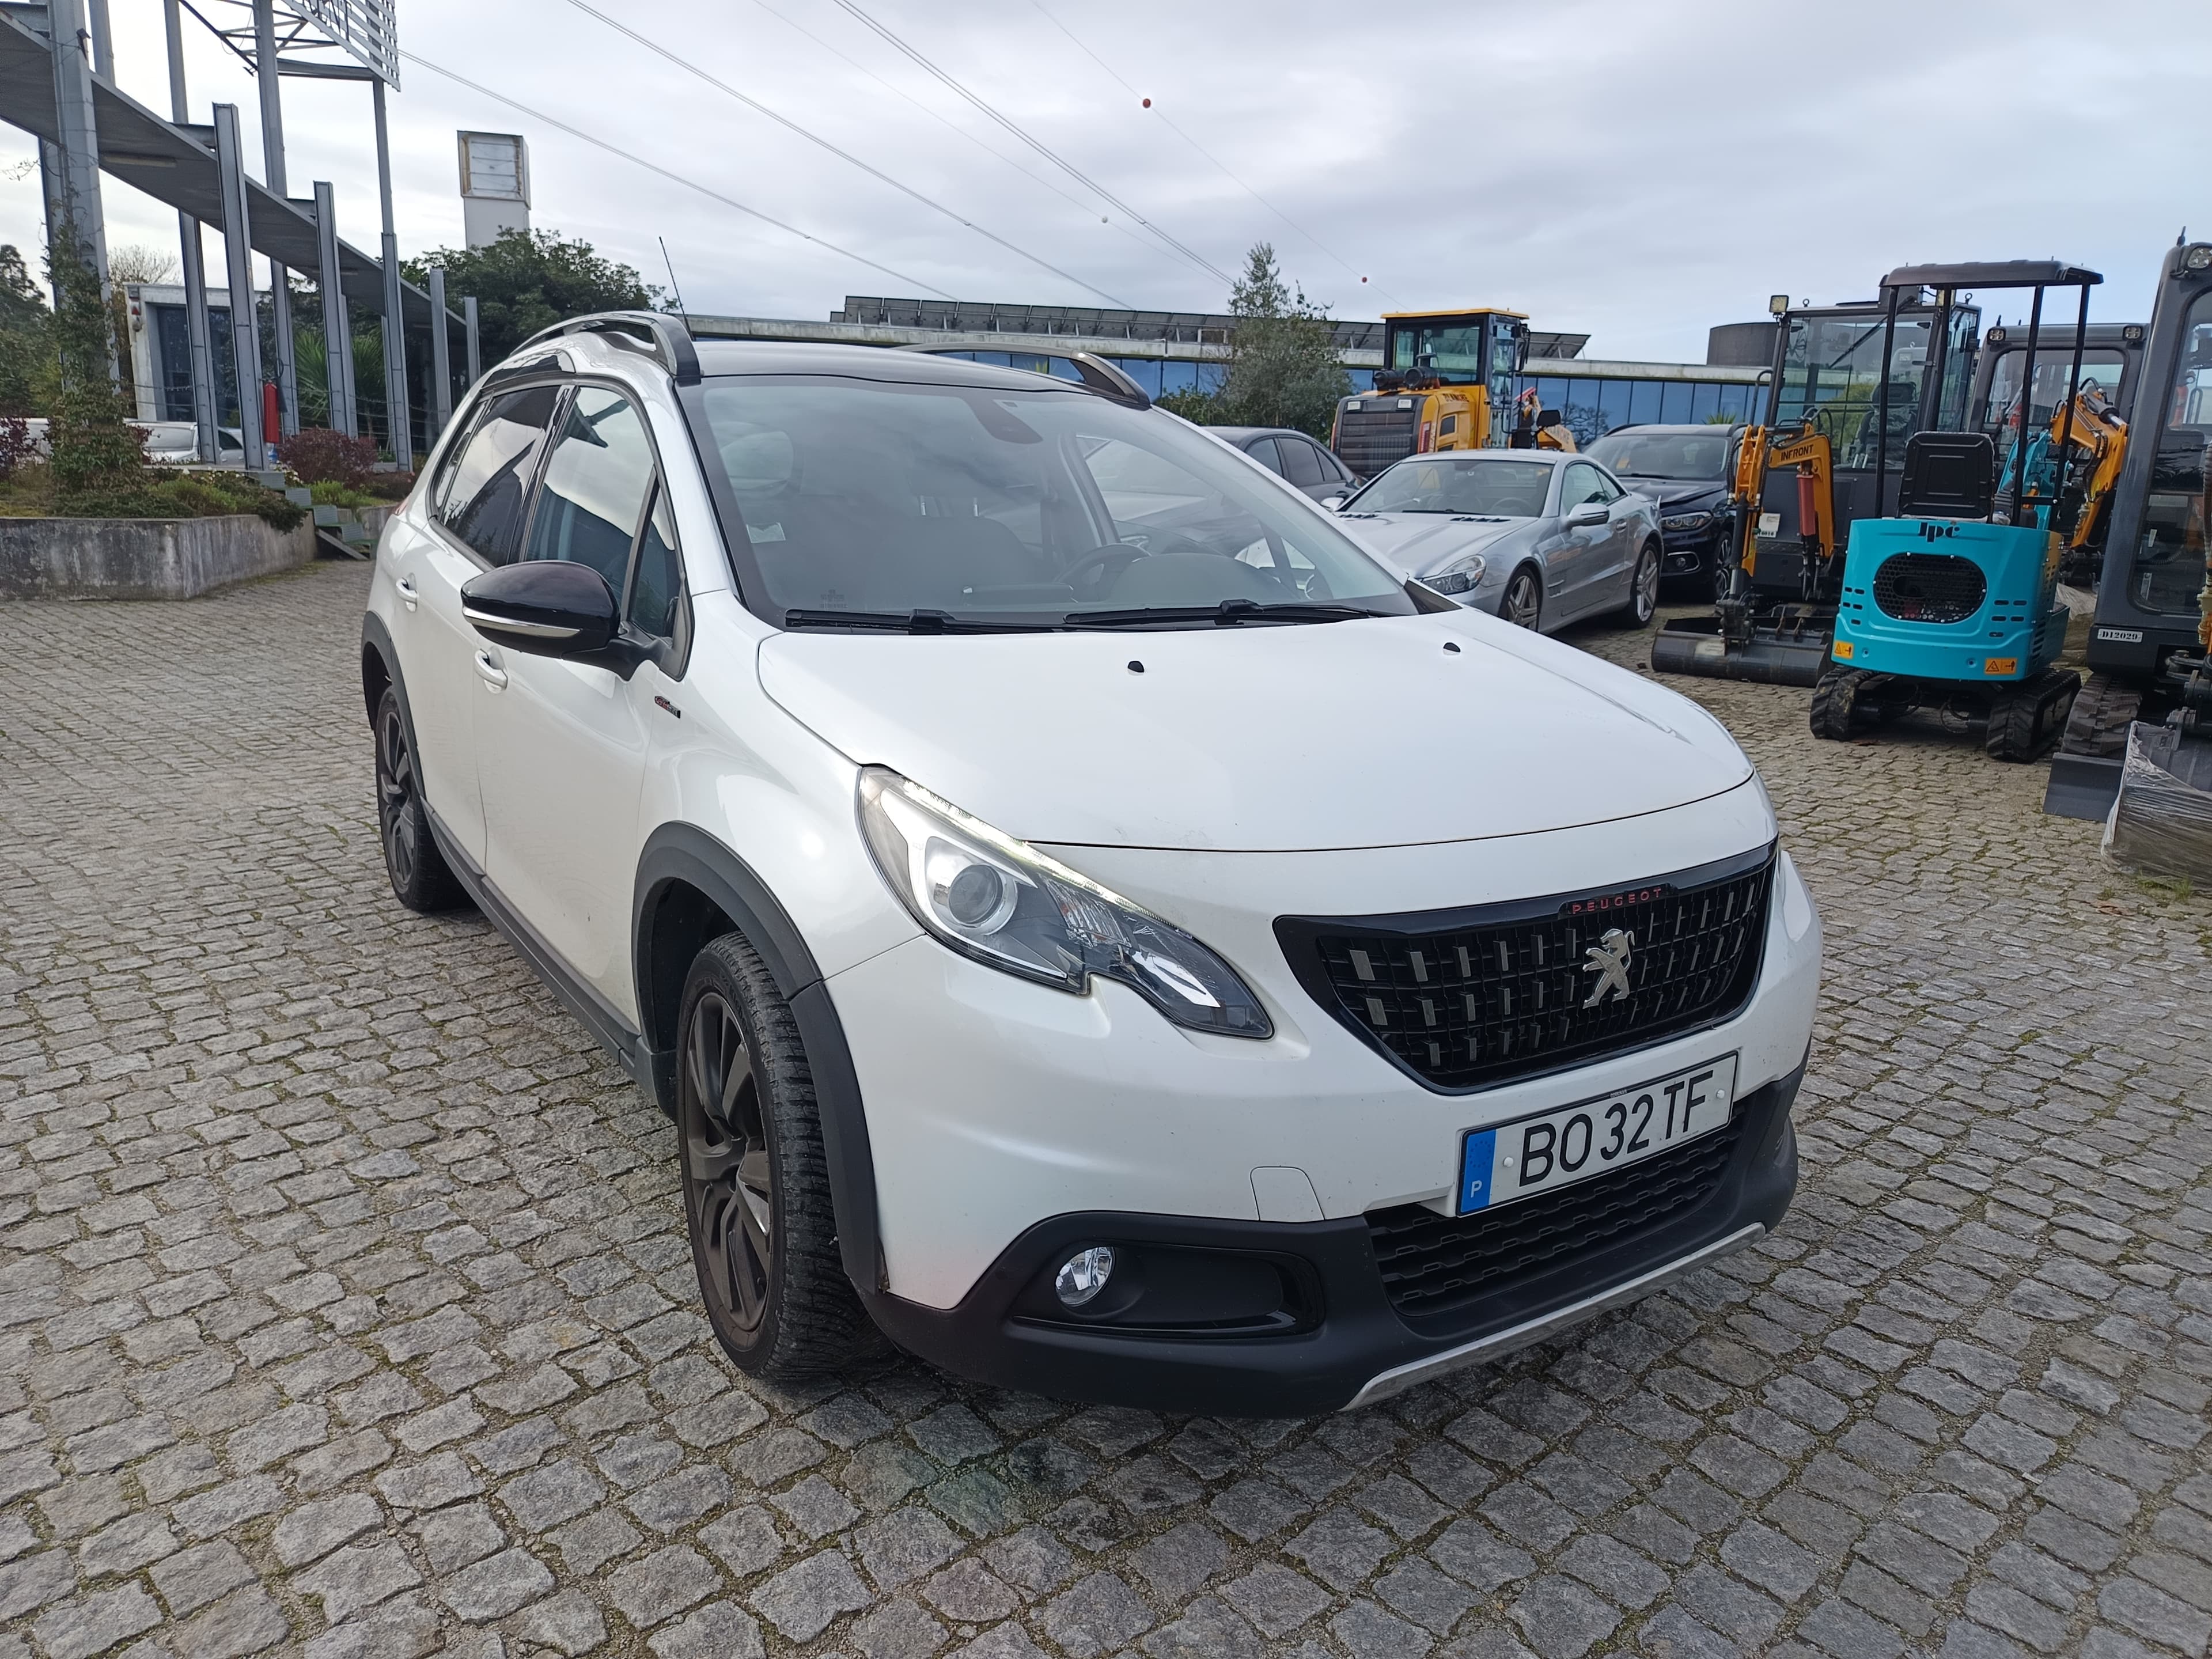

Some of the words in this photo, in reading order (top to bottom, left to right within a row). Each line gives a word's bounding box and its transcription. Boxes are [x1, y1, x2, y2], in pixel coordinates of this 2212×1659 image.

[1781, 444, 1814, 461] INFRONT
[2101, 631, 2138, 640] D12029
[1572, 887, 1662, 915] PEUGEOT
[1518, 1113, 1593, 1187] BO
[1600, 1093, 1654, 1161] 32
[1663, 1070, 1714, 1140] TF
[1470, 1180, 1483, 1198] P
